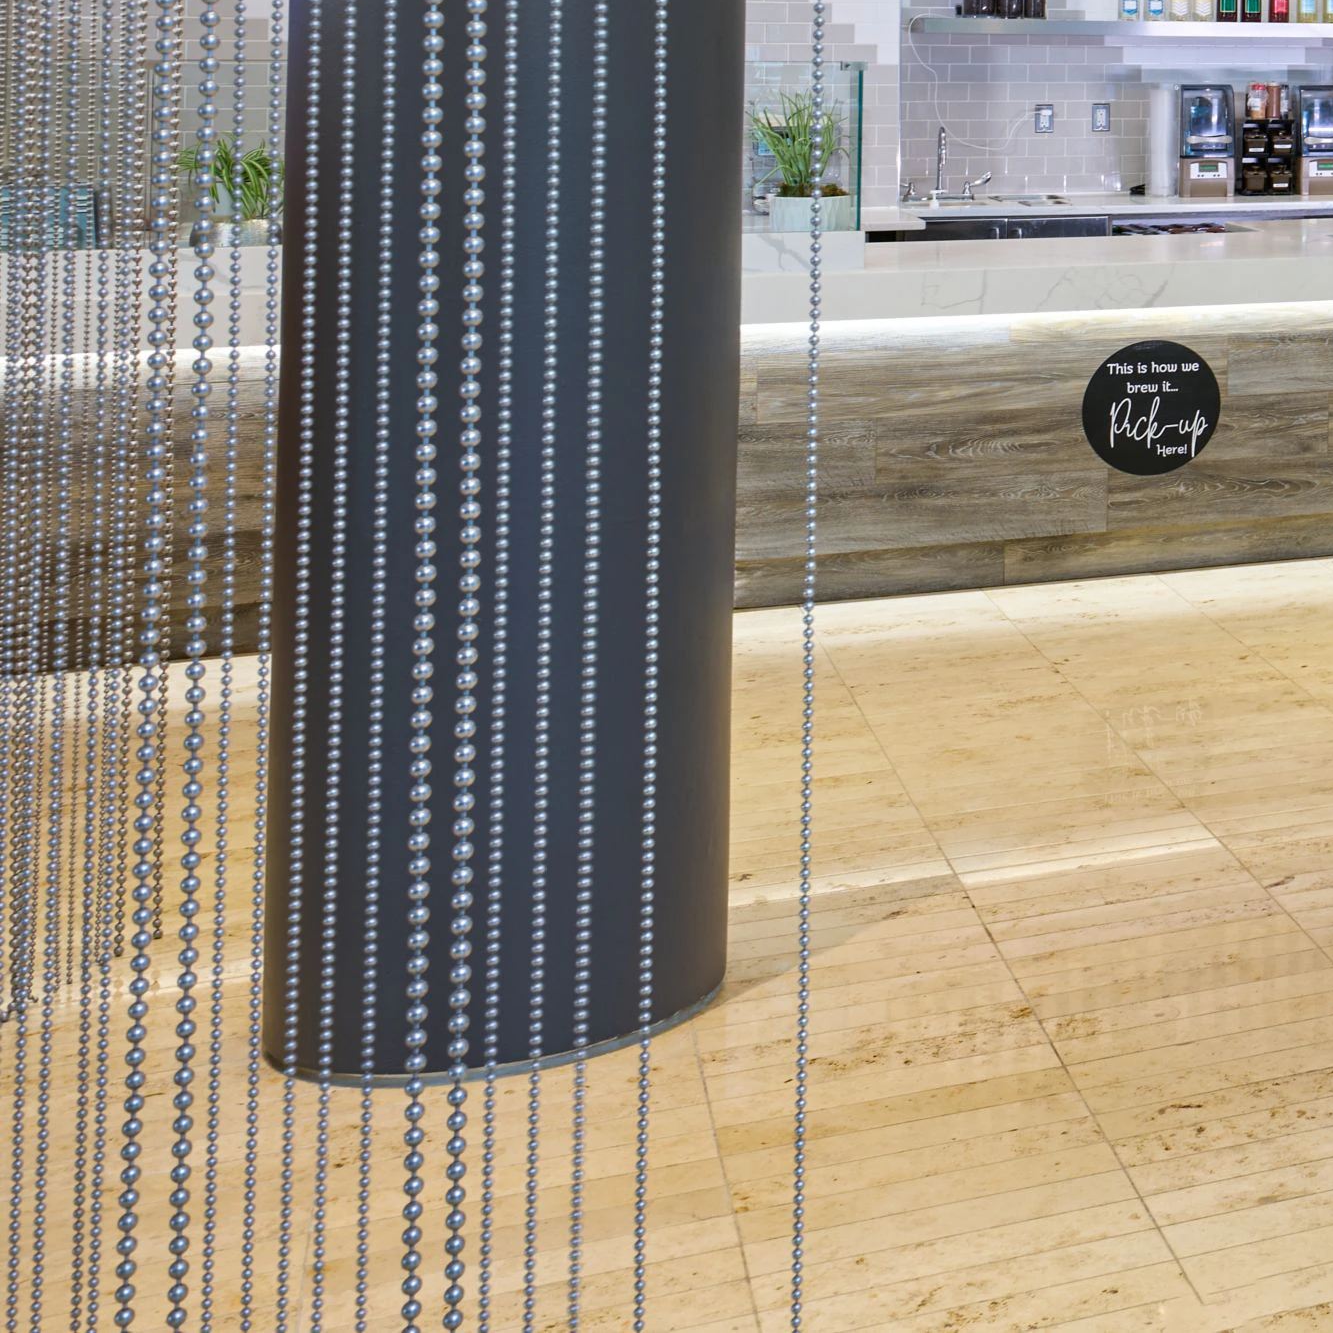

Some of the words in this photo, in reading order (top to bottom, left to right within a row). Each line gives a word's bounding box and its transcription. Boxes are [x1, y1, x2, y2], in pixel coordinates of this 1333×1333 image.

[1107, 363, 1134, 376] This
[1137, 362, 1148, 374] is
[1151, 361, 1178, 374] how
[1181, 362, 1200, 373] we
[1126, 382, 1159, 394] brew
[1162, 381, 1179, 393] it...
[1109, 396, 1208, 458] Pick-up
[1156, 443, 1188, 458] Here!
